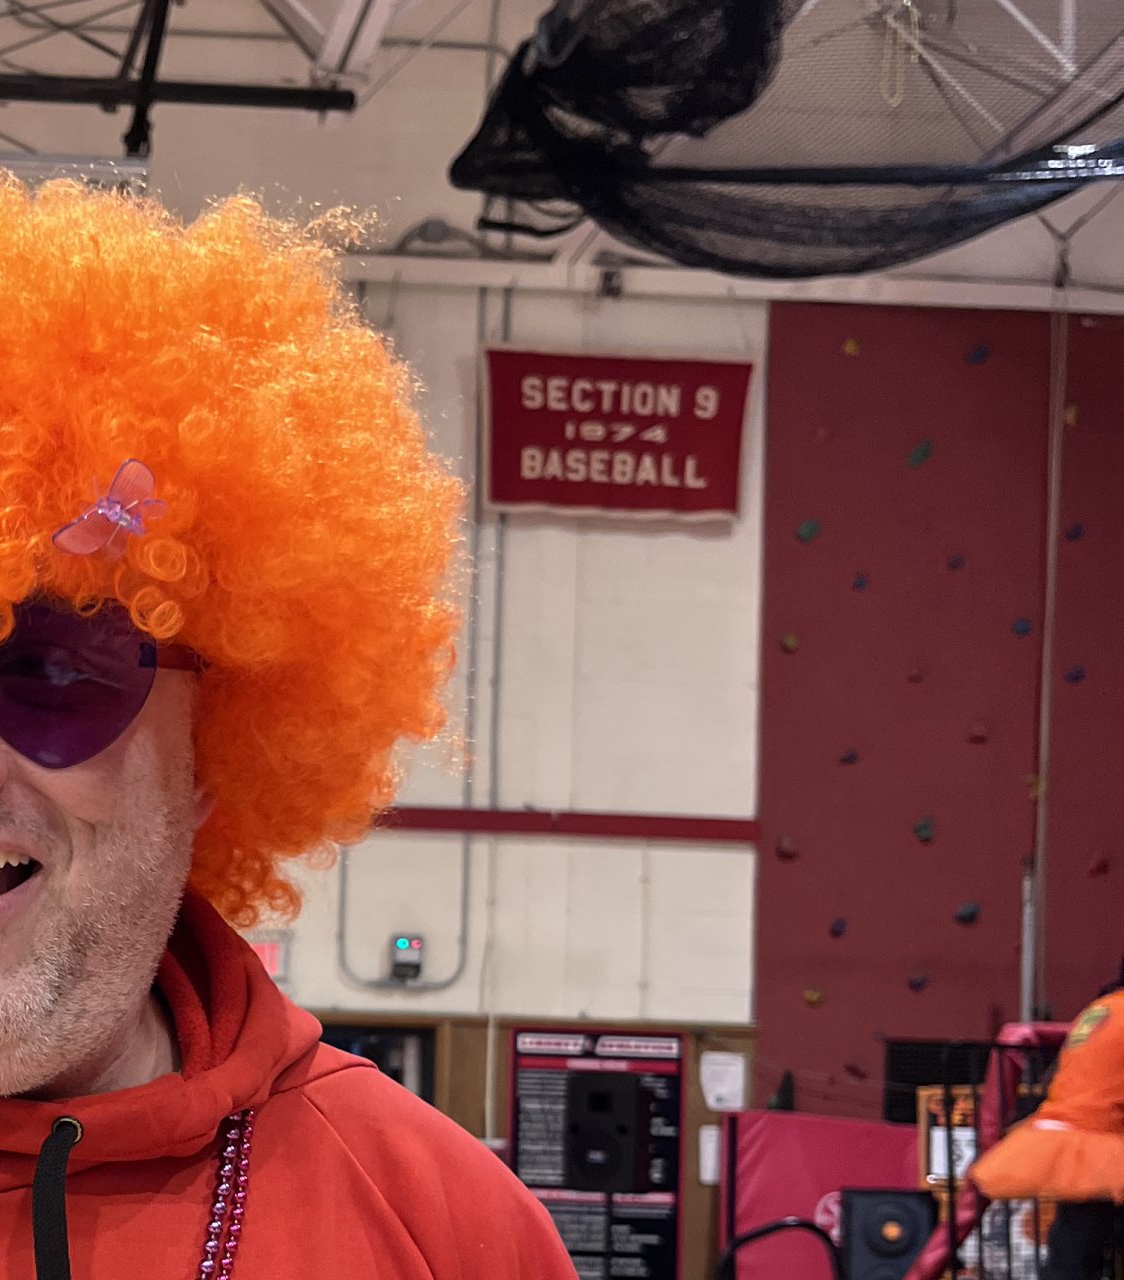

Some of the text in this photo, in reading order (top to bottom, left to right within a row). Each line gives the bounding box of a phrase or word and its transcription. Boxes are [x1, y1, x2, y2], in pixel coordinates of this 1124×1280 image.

[521, 376, 718, 419] SECTION 9
[521, 448, 707, 489] BASEBALL
